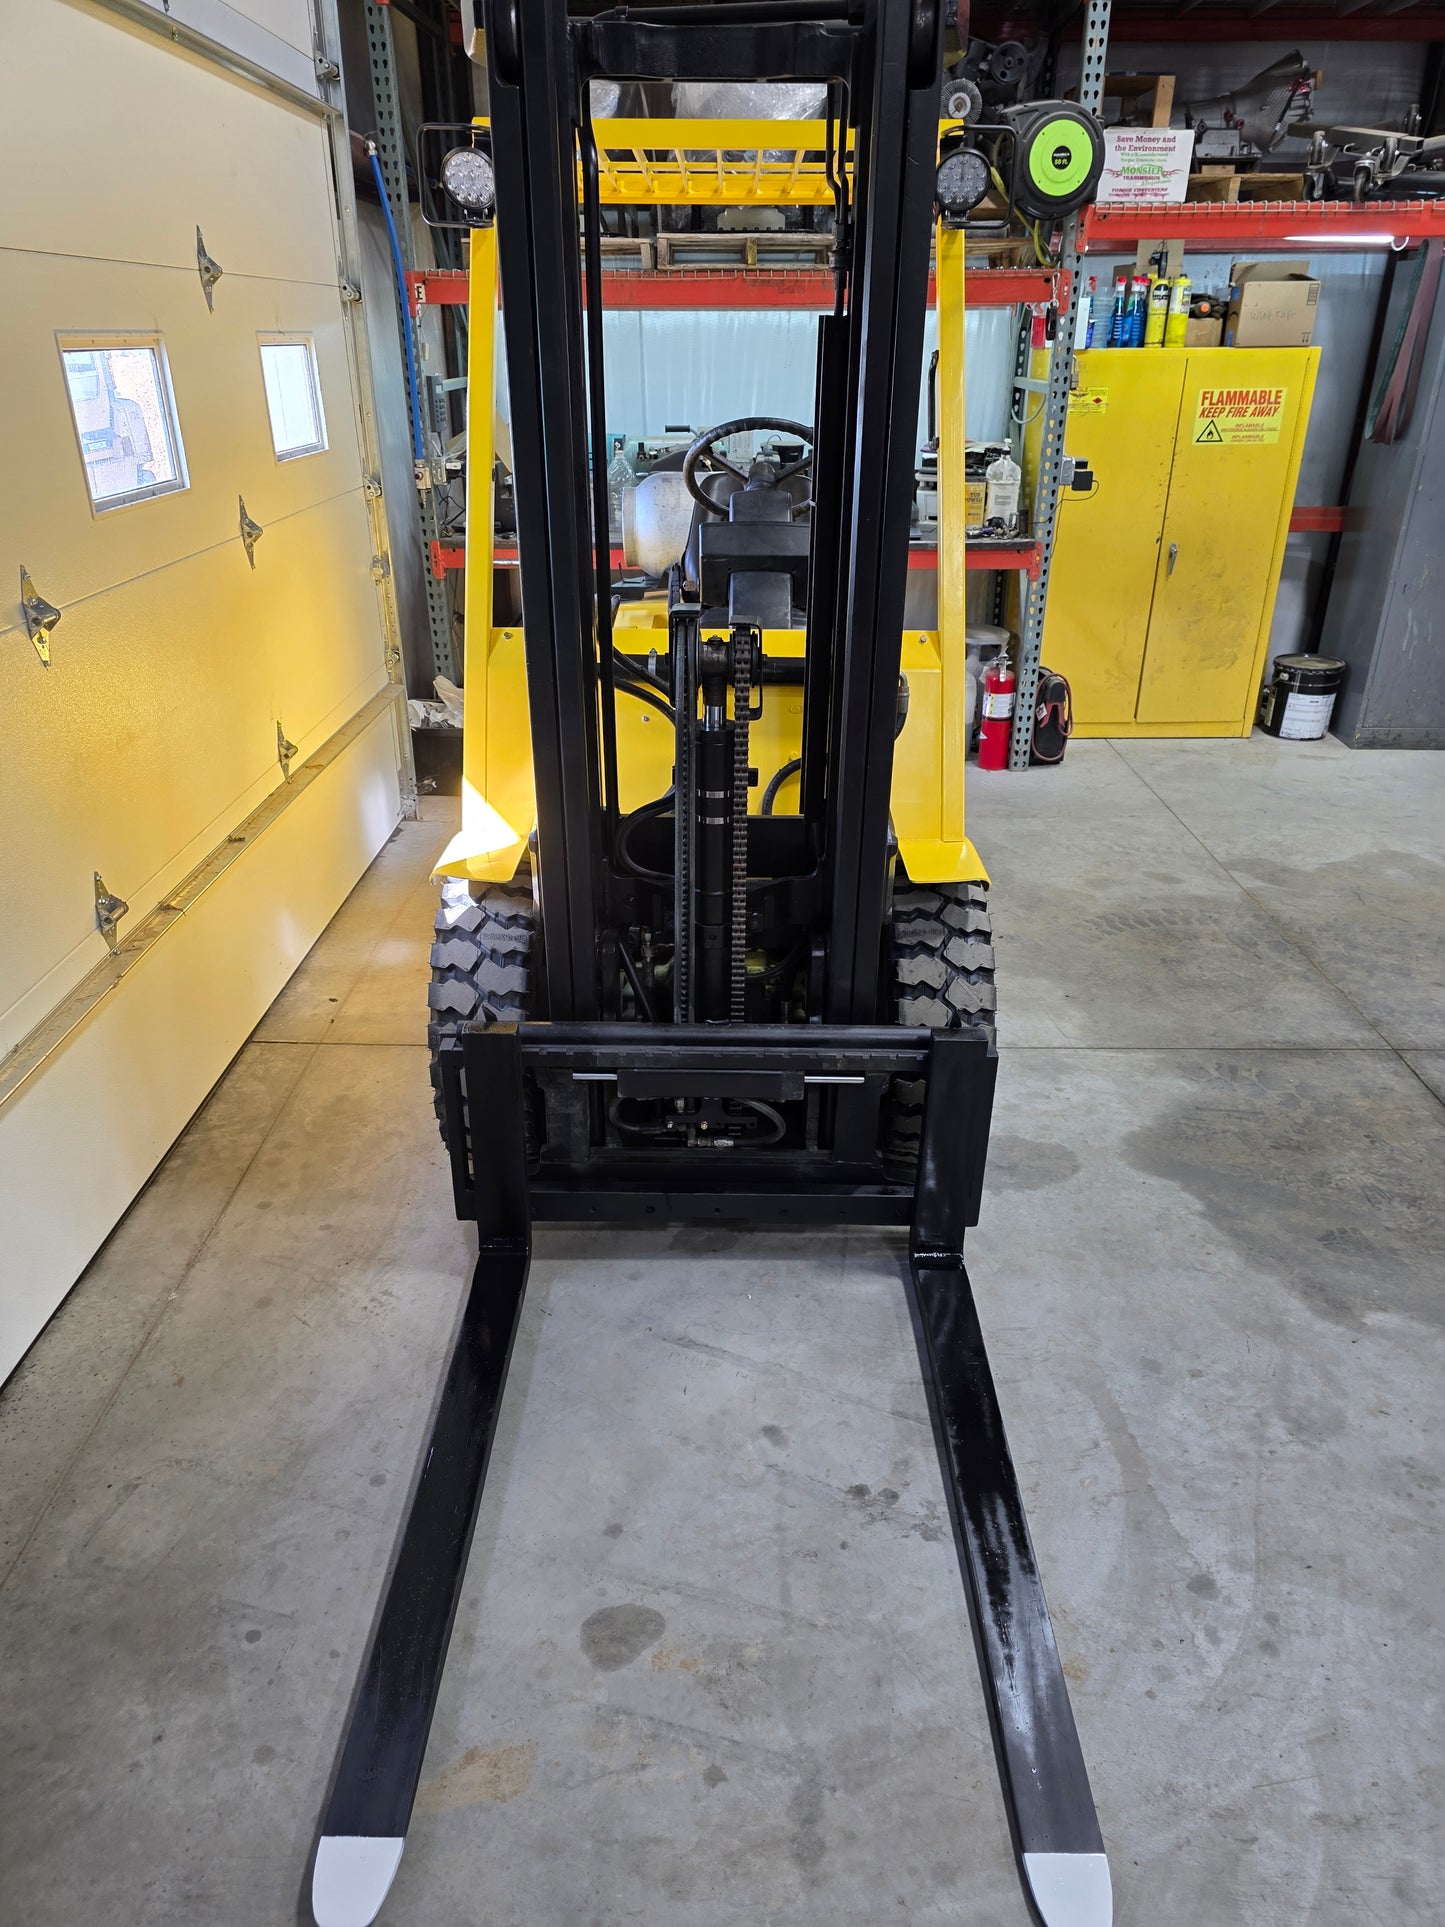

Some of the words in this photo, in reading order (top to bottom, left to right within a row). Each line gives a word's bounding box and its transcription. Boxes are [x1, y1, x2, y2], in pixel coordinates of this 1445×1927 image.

[1135, 136, 1160, 144] Money
[1201, 390, 1283, 406] FLAMMABLE
[1199, 406, 1226, 418] KEEP
[1226, 406, 1250, 418] FIRE
[1249, 406, 1280, 418] AWAY
